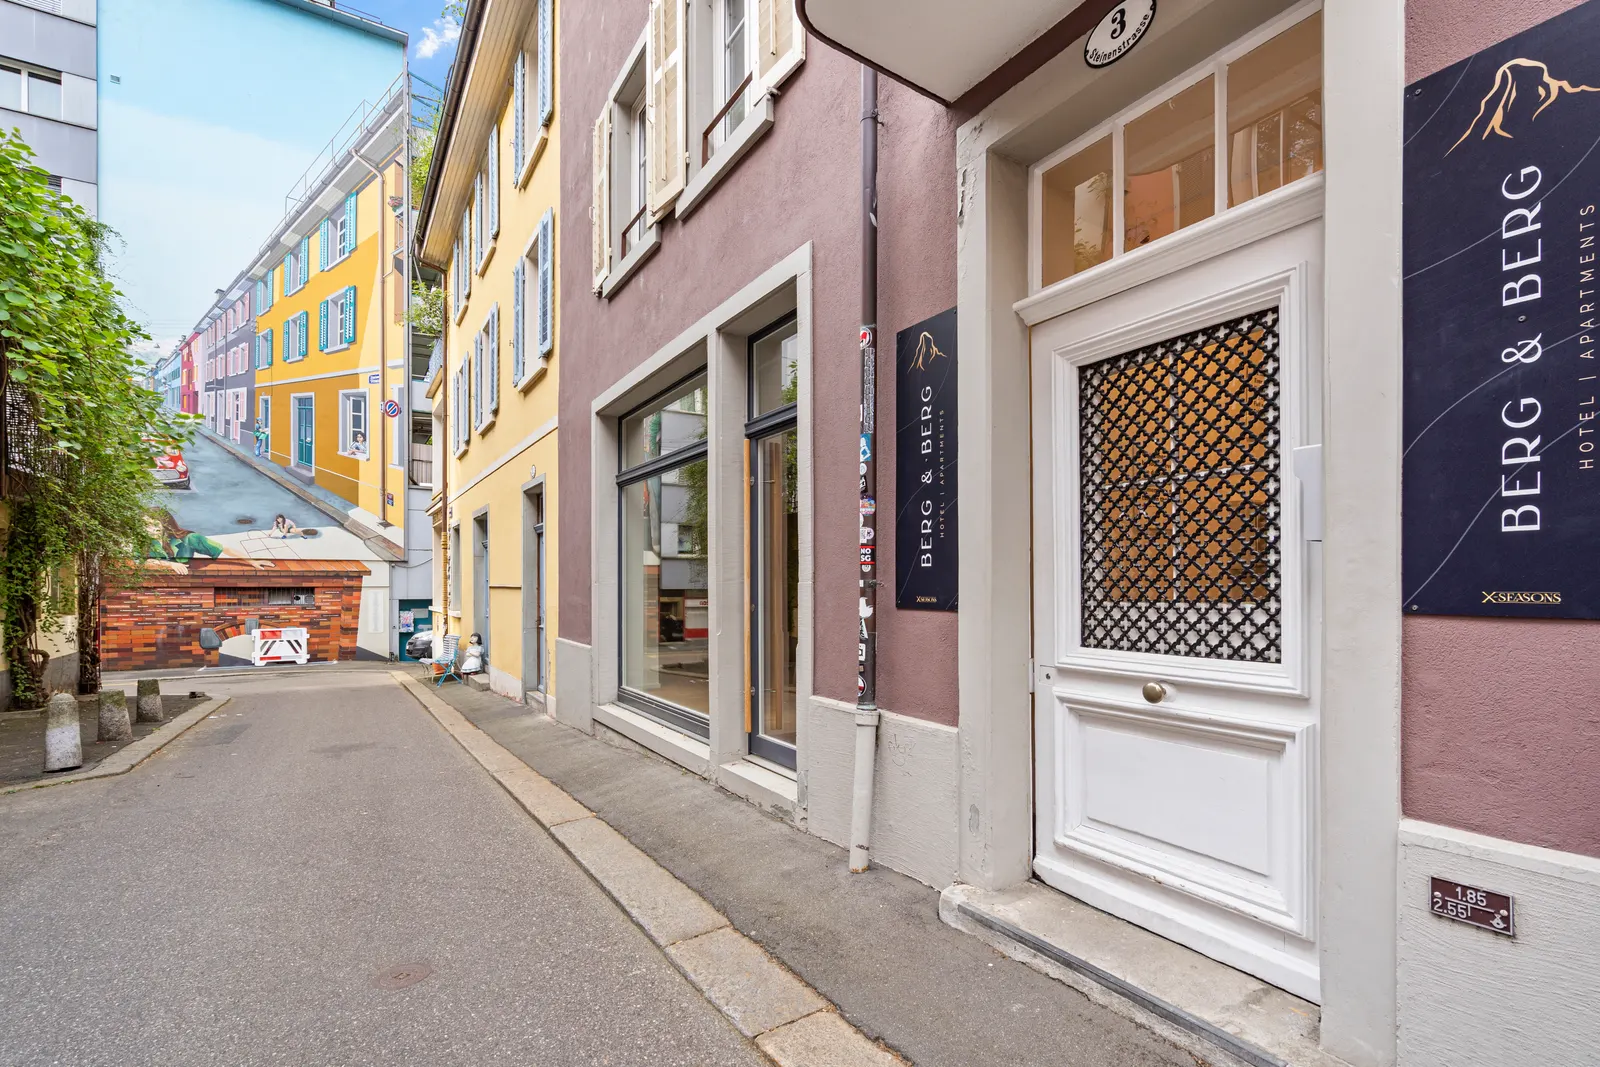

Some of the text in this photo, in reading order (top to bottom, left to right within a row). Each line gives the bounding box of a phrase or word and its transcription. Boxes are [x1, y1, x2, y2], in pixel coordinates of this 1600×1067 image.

[1089, 13, 1150, 63] Steinenstrasse
[1110, 7, 1127, 40] 3
[1579, 204, 1595, 359] APARTMENTS
[1501, 165, 1543, 533] BERG & BERG
[1579, 395, 1595, 470] HOTEL
[920, 385, 933, 567] BERG & BERG
[1433, 898, 1467, 919] 2.55
[1455, 886, 1487, 906] 1.85
